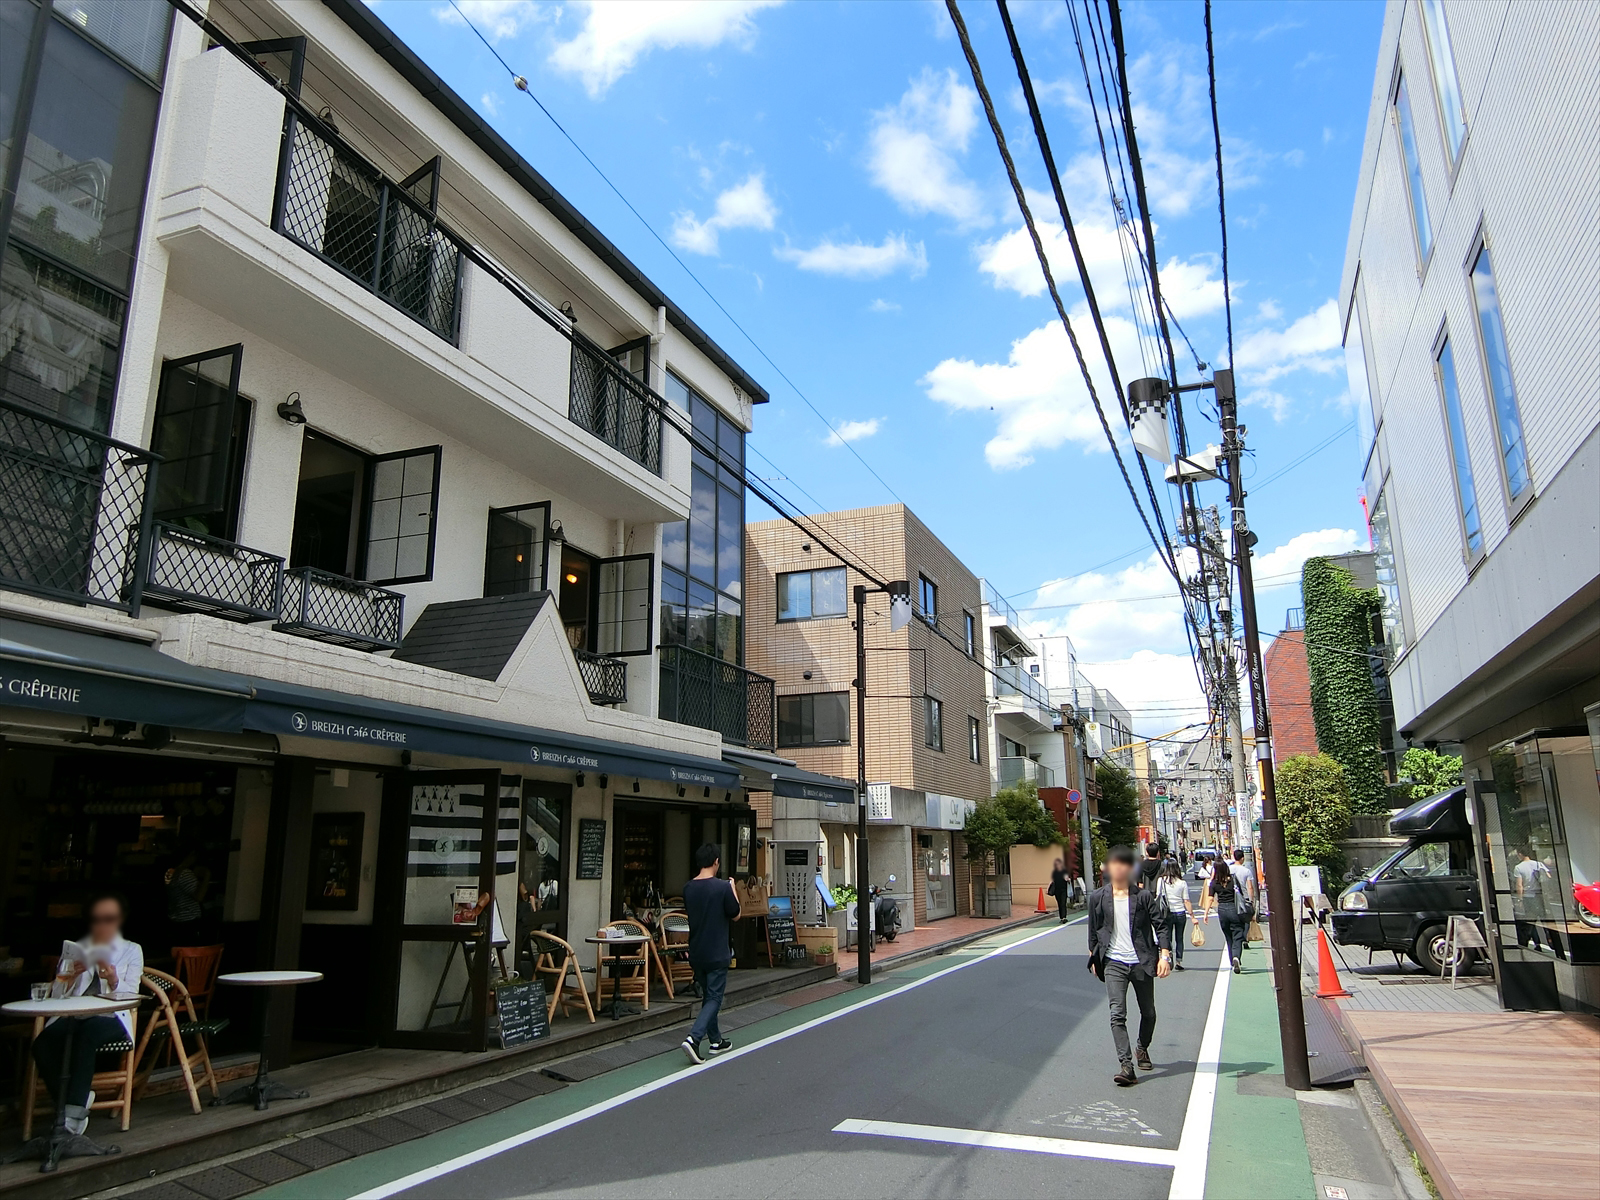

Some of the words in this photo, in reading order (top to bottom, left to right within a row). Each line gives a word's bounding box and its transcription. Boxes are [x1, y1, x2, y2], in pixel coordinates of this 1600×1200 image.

[1251, 652, 1260, 682] Chome
[8, 678, 81, 703] CRÊPERIE
[1253, 682, 1261, 691] 2
[1256, 692, 1266, 732] Harajuku
[311, 720, 345, 735] BREIZH
[346, 725, 369, 738] Café
[370, 728, 407, 744] CRÊPERIE
[542, 751, 562, 763] BREIZH
[562, 754, 576, 764] Café
[576, 756, 599, 768] CRÊPERIE
